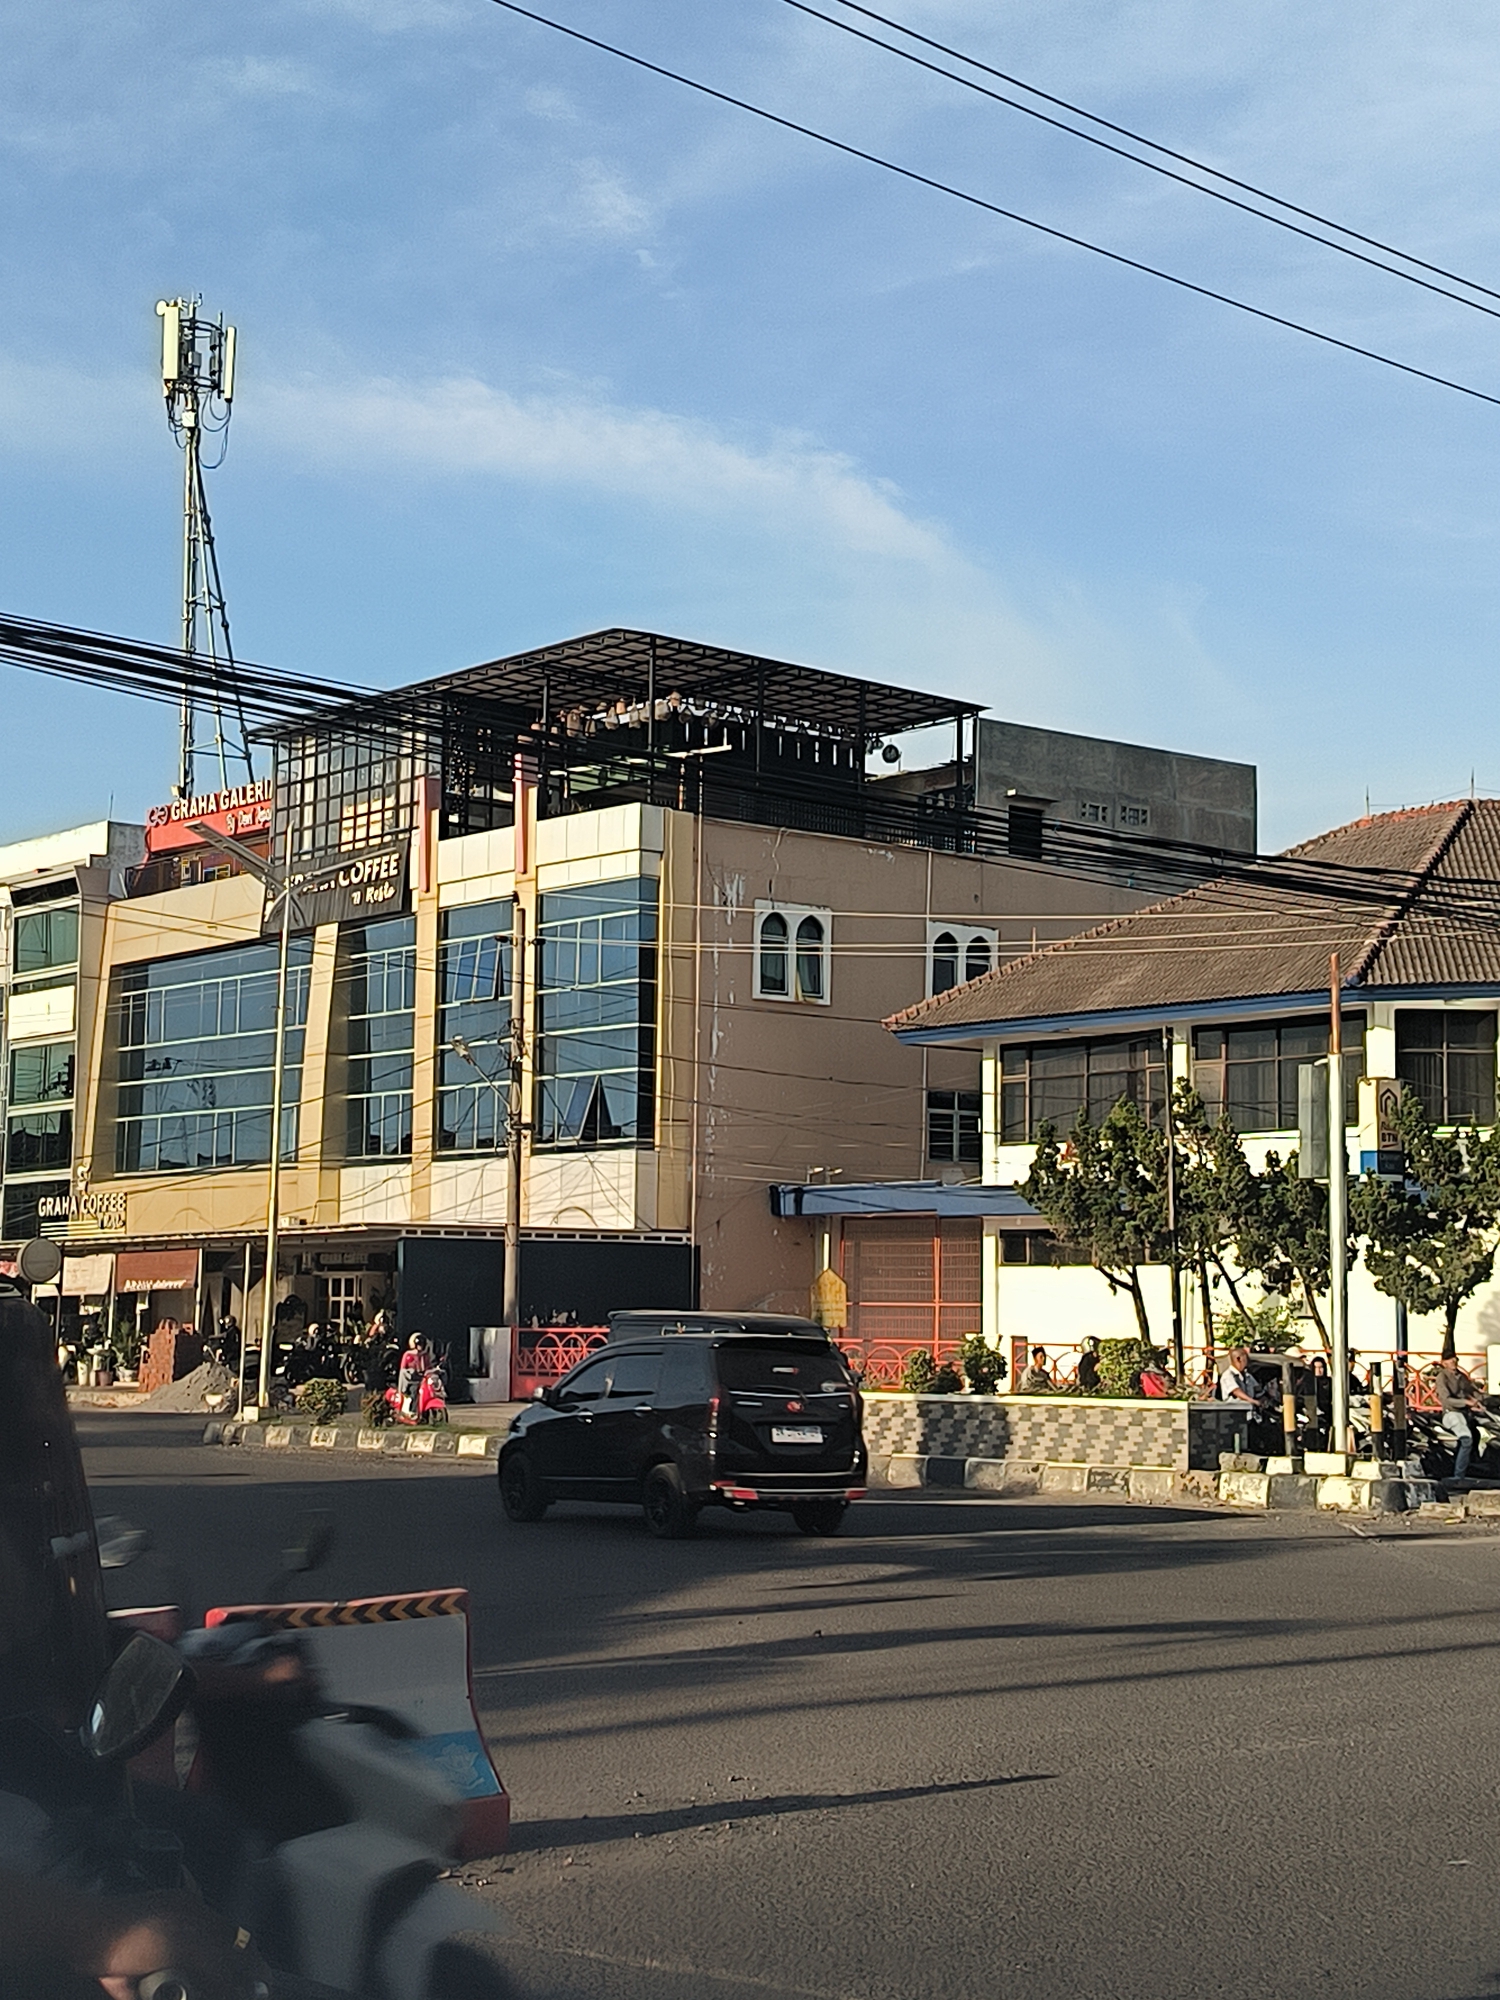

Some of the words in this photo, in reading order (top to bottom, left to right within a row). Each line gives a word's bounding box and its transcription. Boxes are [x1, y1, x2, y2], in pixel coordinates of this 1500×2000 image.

[171, 792, 217, 821] GRAHA
[339, 853, 400, 887] COFFEE
[38, 1195, 78, 1218] GRAHA
[80, 1191, 126, 1215] COFFEE
